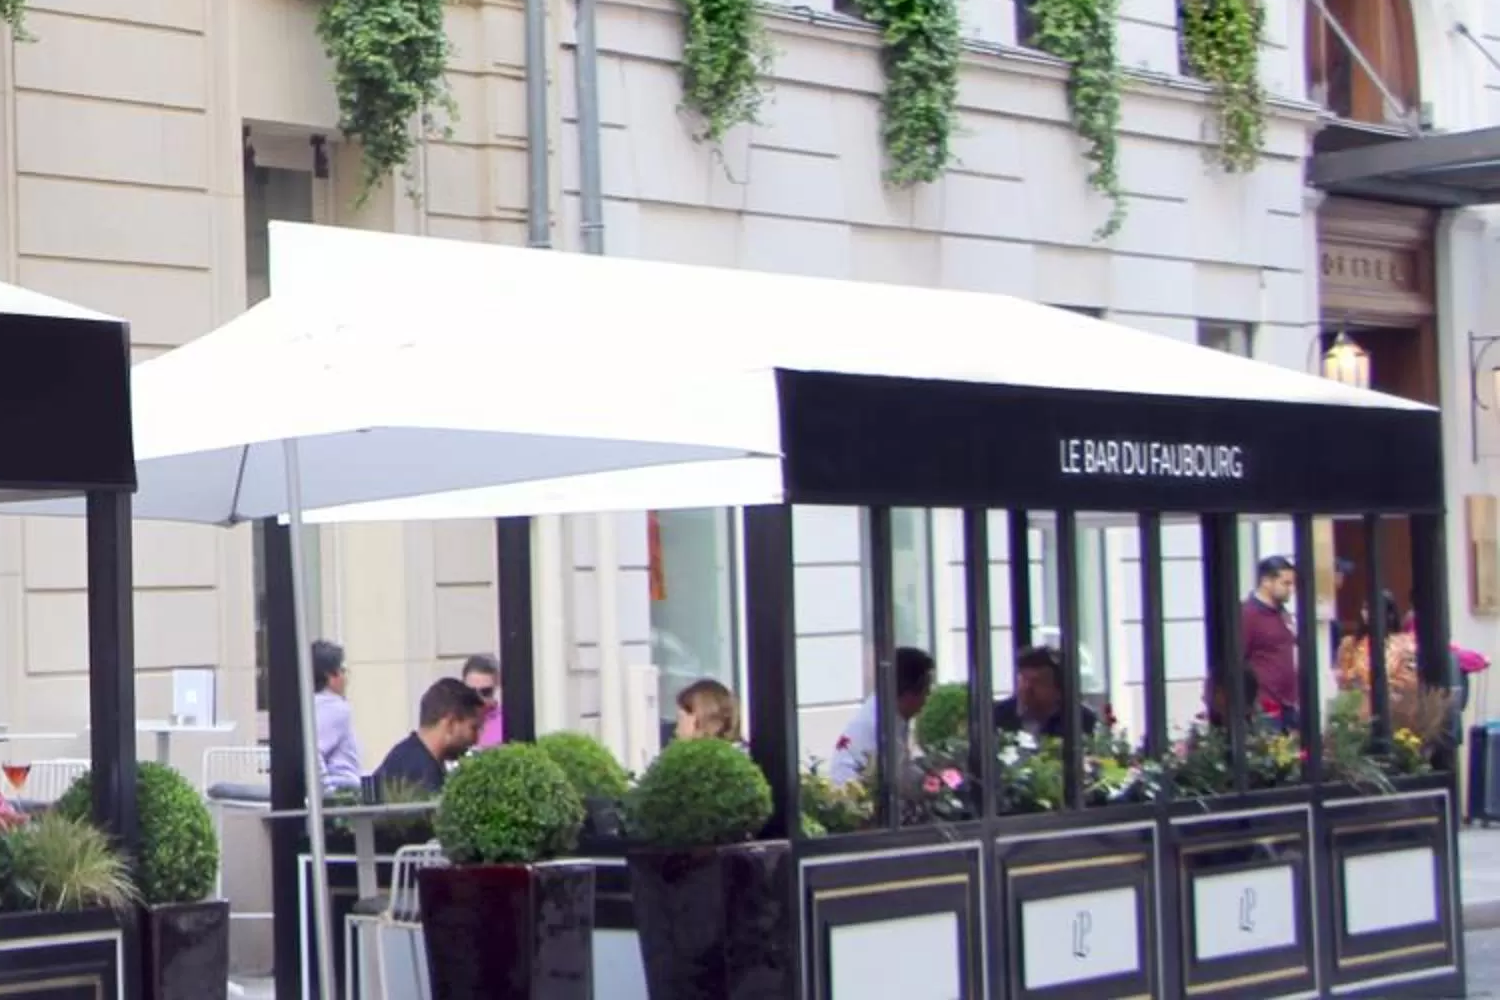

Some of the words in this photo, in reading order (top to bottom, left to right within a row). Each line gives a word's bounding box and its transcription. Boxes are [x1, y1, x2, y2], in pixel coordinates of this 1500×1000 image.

[1060, 439, 1081, 473] LE
[1083, 439, 1119, 474] BAR
[1121, 441, 1148, 475] DU
[1151, 443, 1244, 478] FAUBOURG
